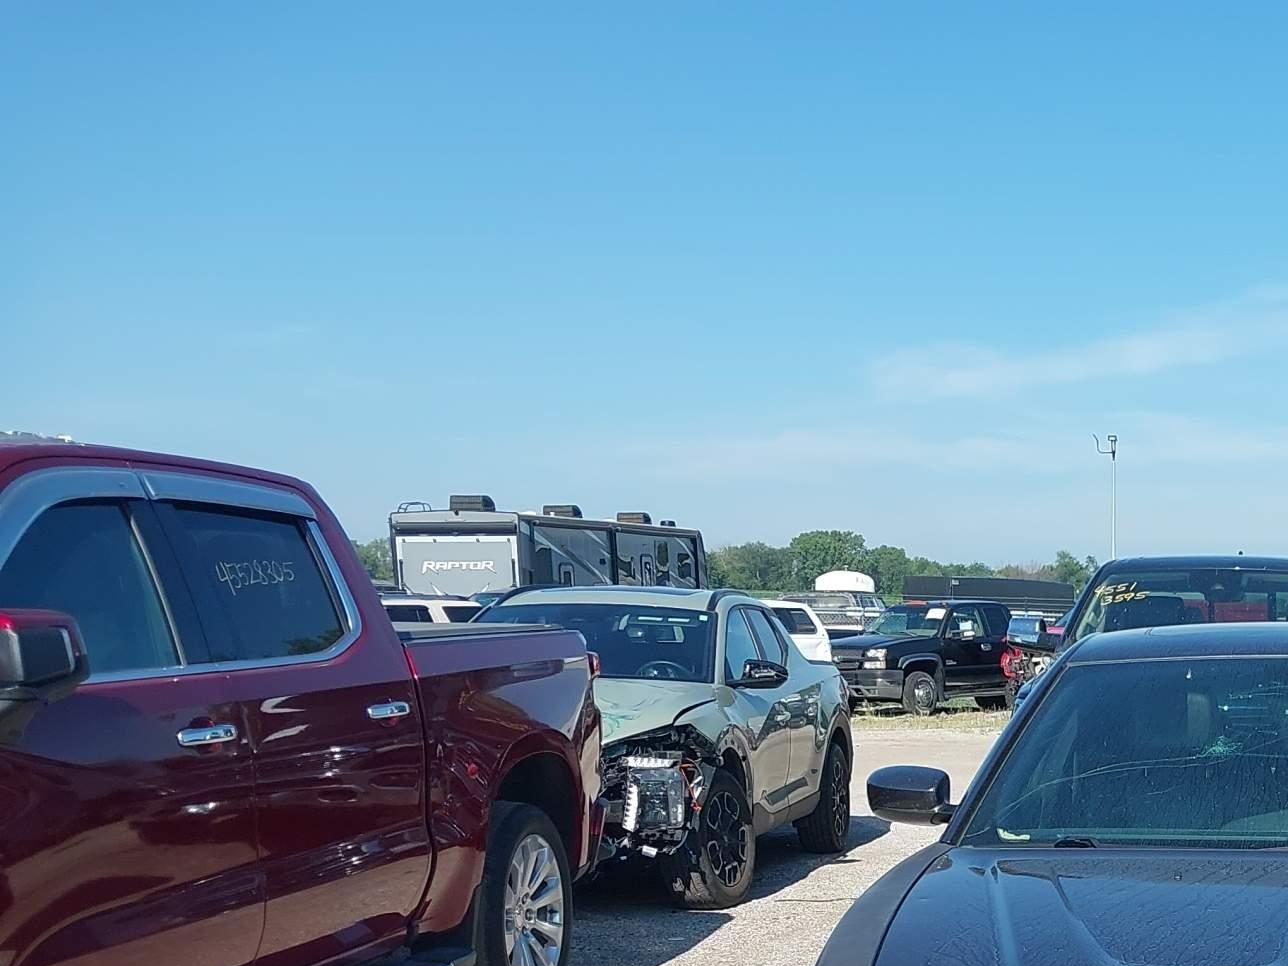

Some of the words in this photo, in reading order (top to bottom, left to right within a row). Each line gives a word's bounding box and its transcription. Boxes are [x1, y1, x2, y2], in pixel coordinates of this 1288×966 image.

[421, 560, 497, 575] RAPTOR
[1094, 581, 1137, 598] 4551
[1100, 591, 1151, 606] 3595
